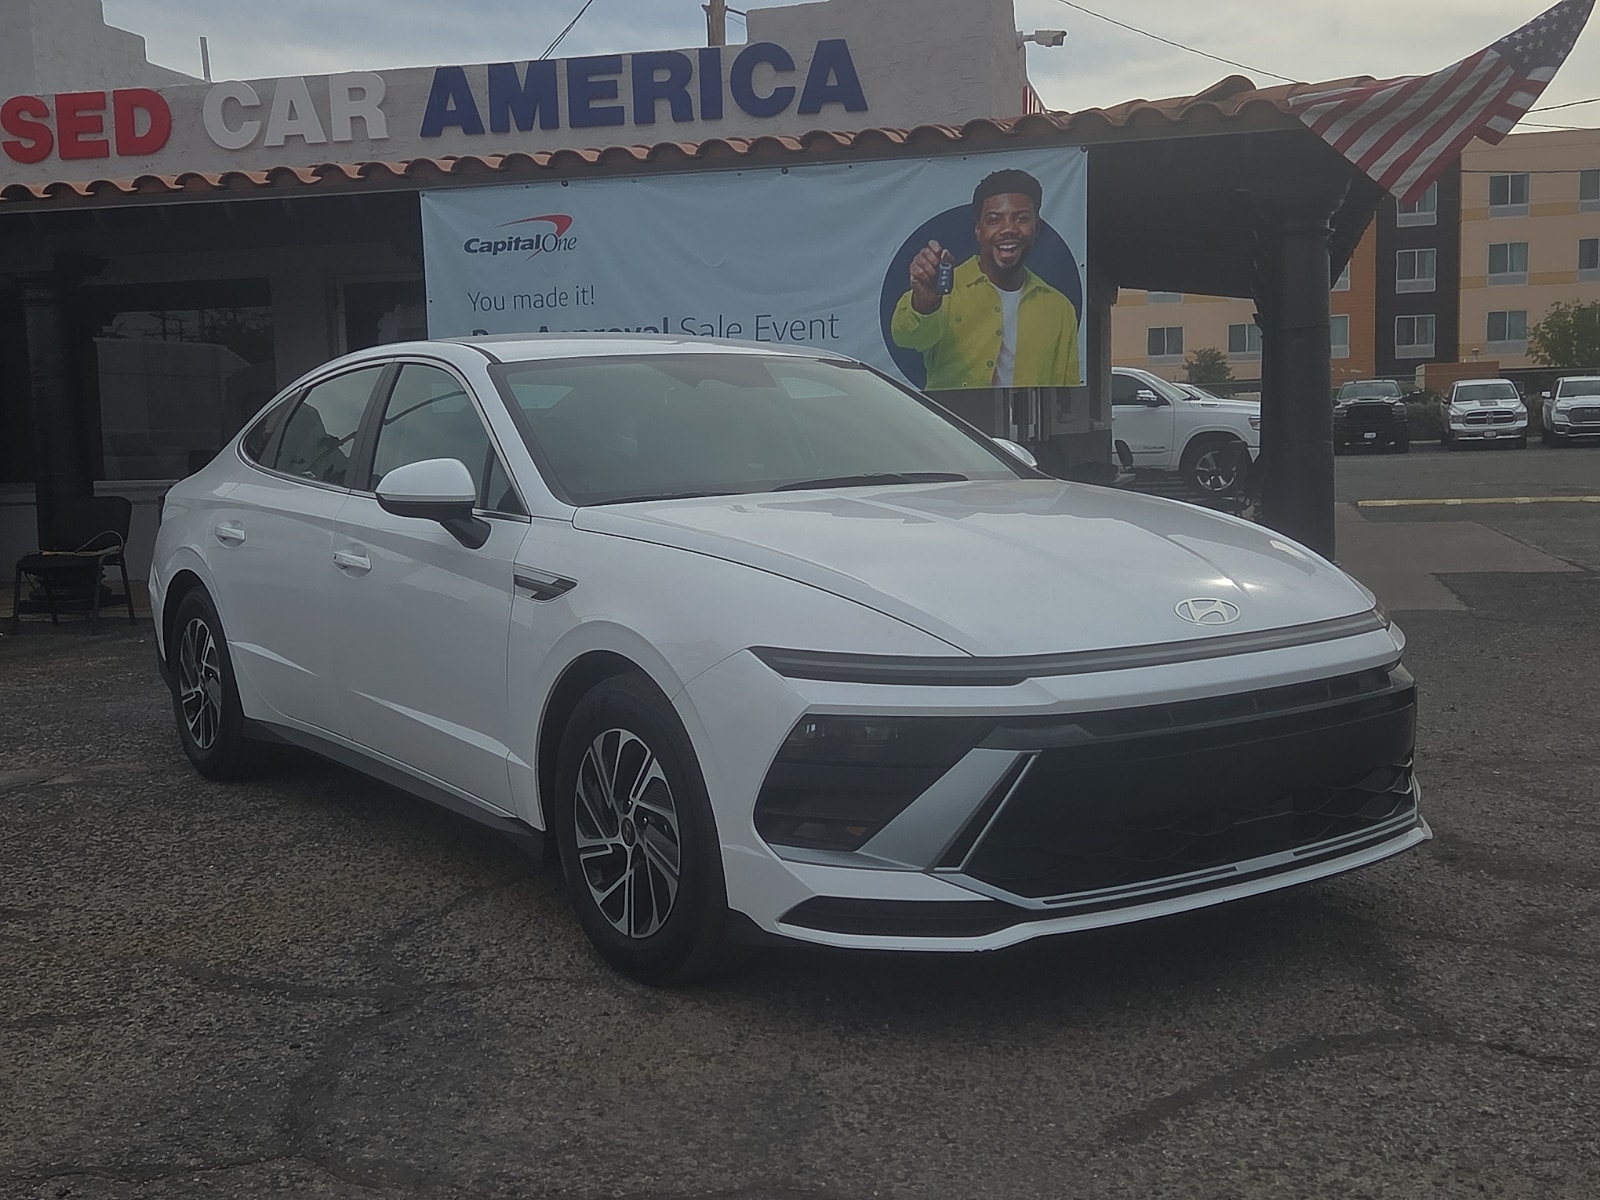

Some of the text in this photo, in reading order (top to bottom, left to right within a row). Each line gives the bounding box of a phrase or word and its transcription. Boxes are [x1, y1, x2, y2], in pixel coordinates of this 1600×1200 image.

[202, 72, 389, 150] CAR
[420, 38, 869, 138] AMERICA
[467, 284, 595, 312] You made it!
[680, 314, 743, 339] Sale
[755, 313, 840, 342] Event
